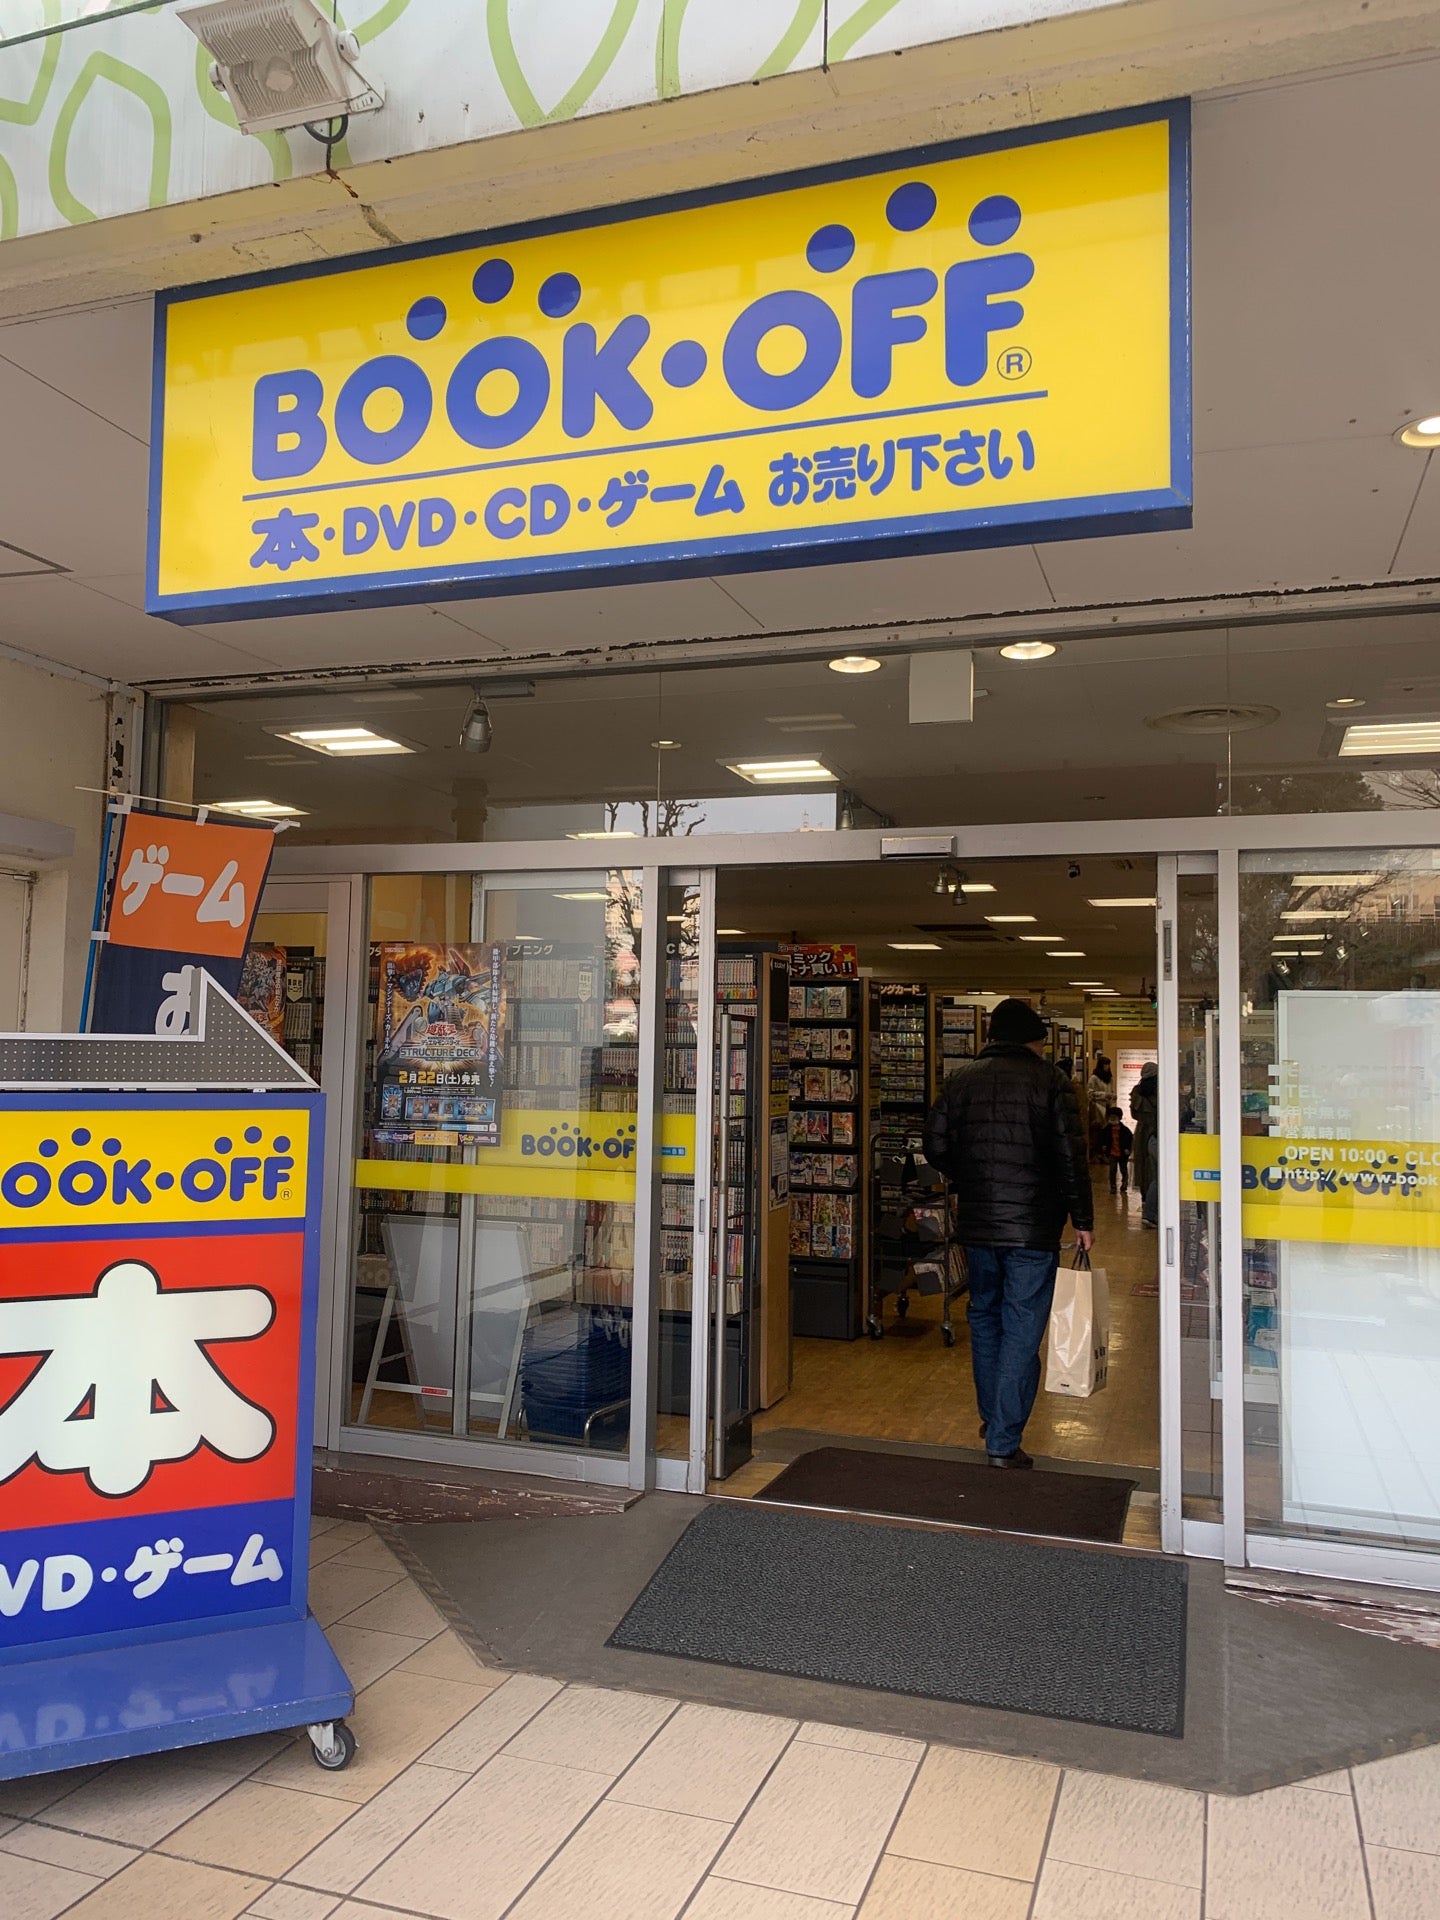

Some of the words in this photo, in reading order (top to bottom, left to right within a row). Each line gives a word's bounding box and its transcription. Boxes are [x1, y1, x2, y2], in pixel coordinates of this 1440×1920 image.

[768, 428, 1036, 507] お売り下さい
[120, 843, 246, 929] ゲーム
[400, 1047, 454, 1057] STRUCTURE
[456, 1048, 480, 1057] DECK
[1285, 1146, 1334, 1161] OPEN
[1340, 1148, 1387, 1164] 10:00
[0, 1258, 277, 1500] 本
